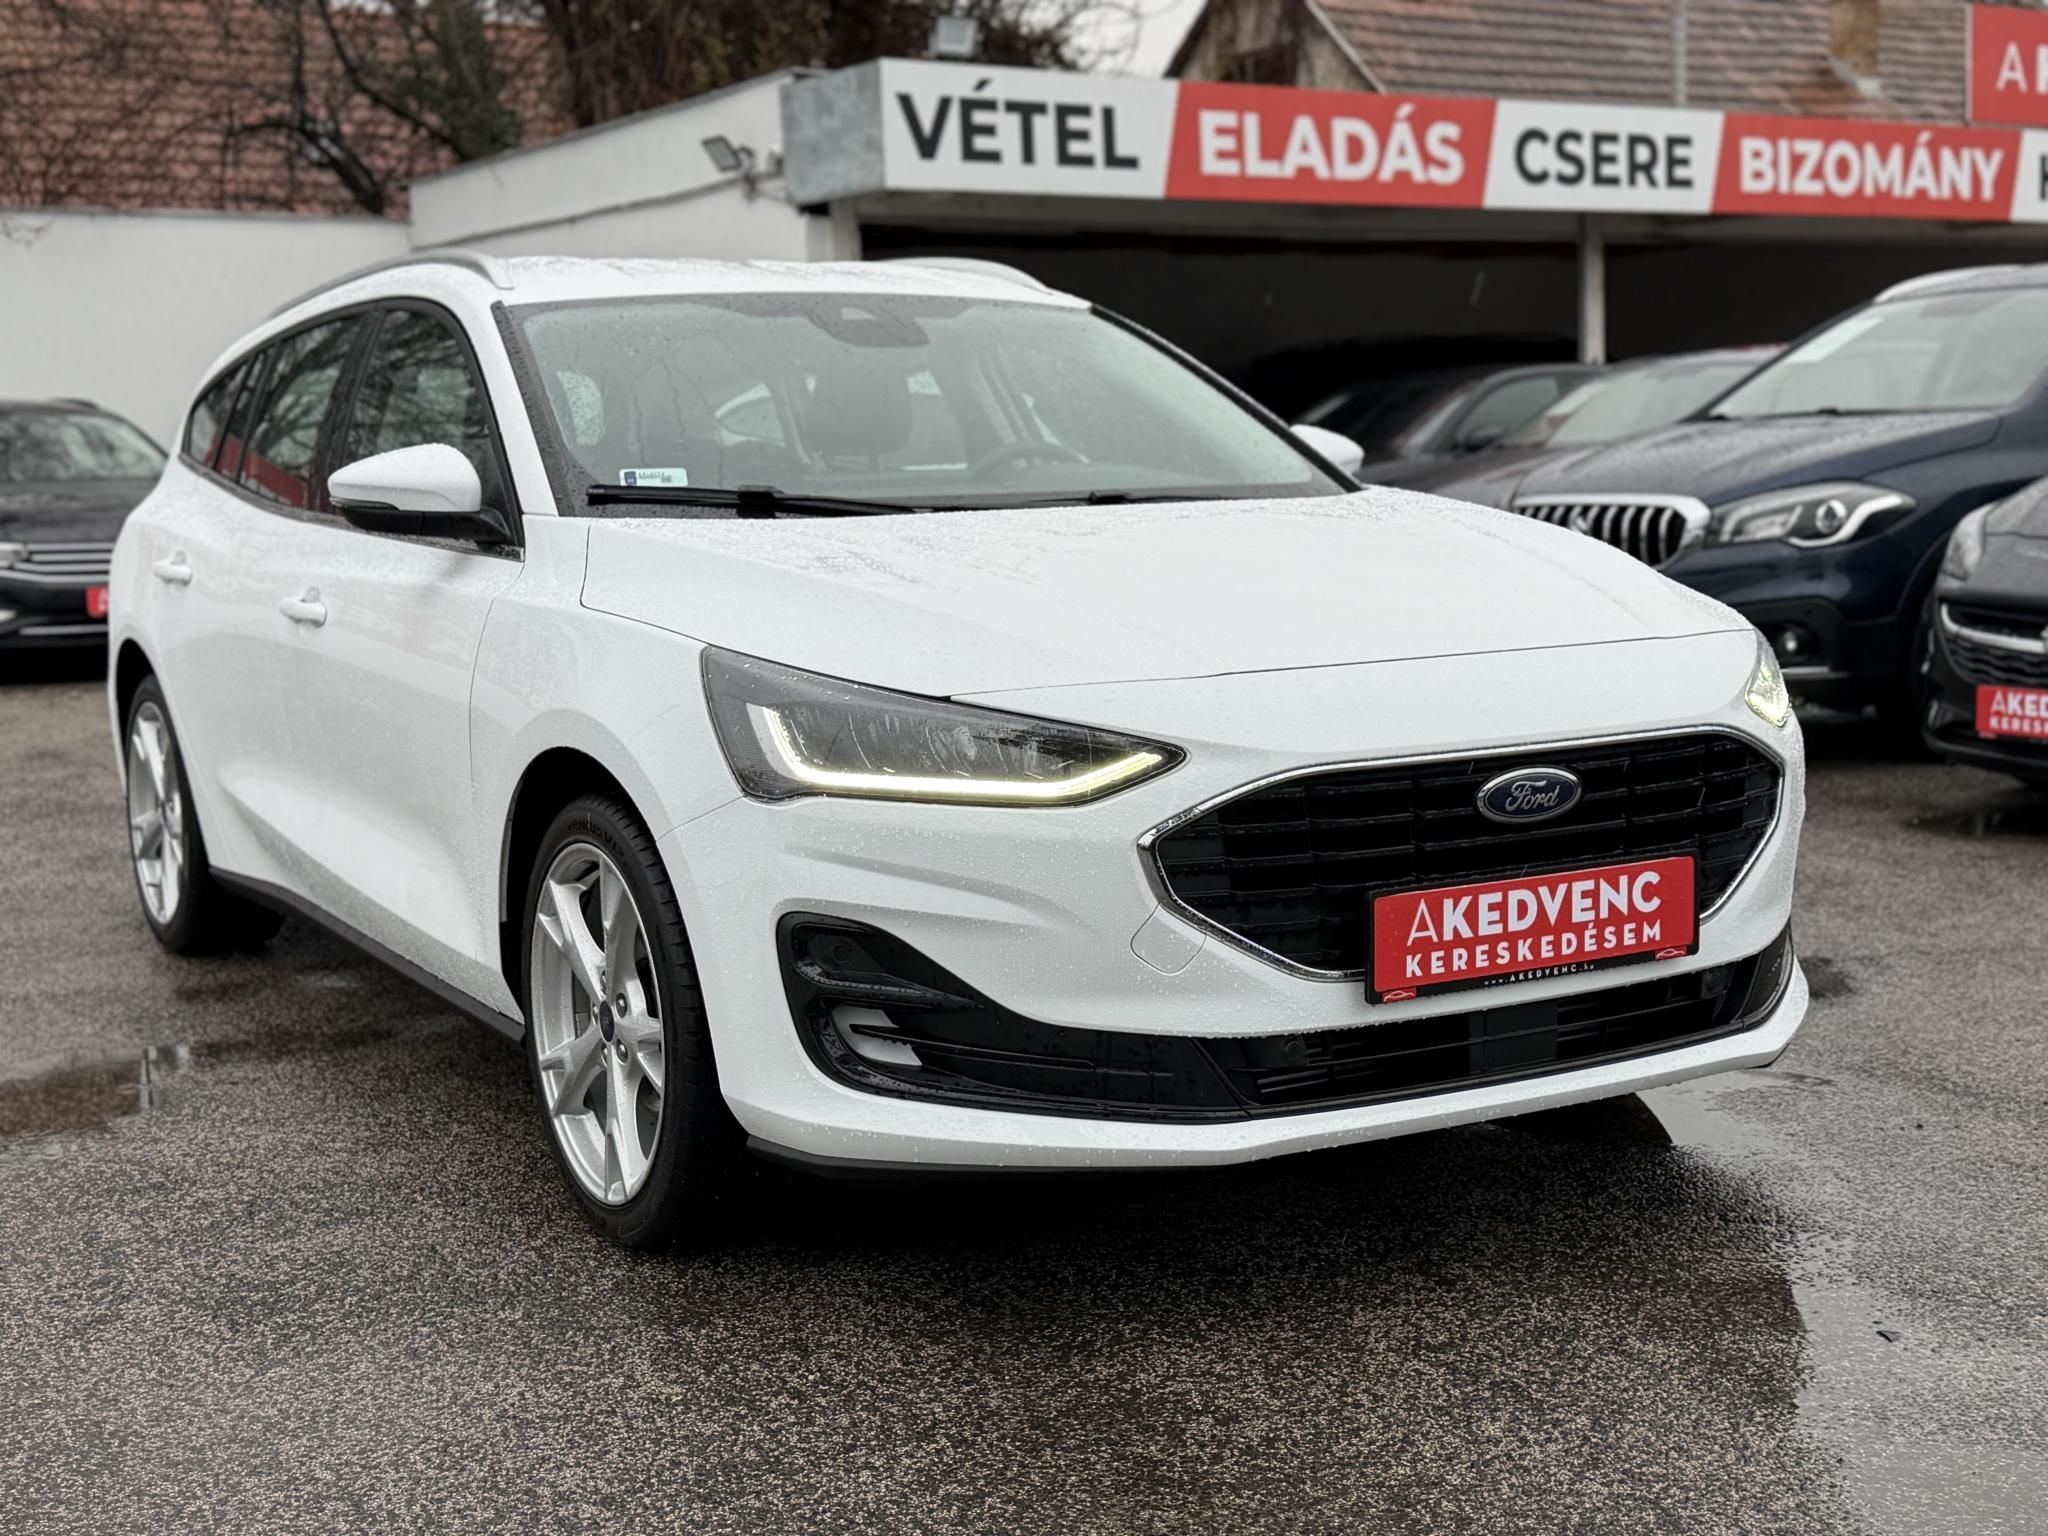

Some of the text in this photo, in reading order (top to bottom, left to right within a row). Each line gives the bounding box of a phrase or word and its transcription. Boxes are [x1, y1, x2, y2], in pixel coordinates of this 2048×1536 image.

[895, 78, 1140, 169] VÉTEL
[1199, 102, 1465, 186] ELADÁS
[1514, 128, 1694, 188] CSERE
[1740, 130, 2003, 202] BIZOMÁNY
[1505, 780, 1561, 812] Ford
[1406, 920, 1661, 978] KERESKEDÉSEM
